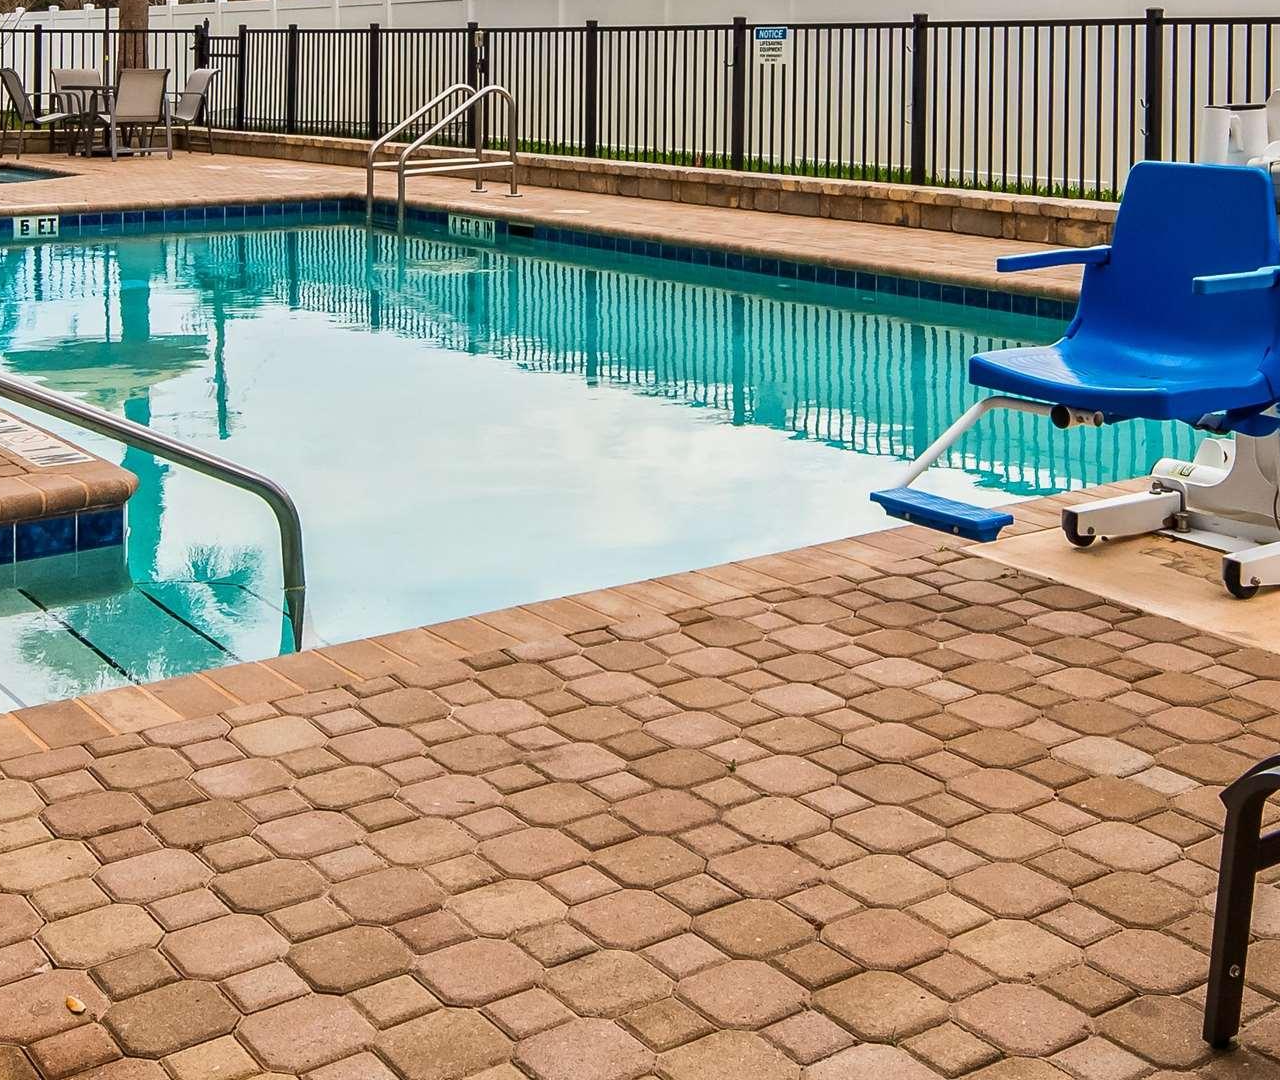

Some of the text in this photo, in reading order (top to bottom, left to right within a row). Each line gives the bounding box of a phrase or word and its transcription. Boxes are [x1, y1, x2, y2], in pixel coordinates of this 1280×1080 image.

[759, 29, 784, 38] NOTICE
[21, 445, 89, 466] 1 M
